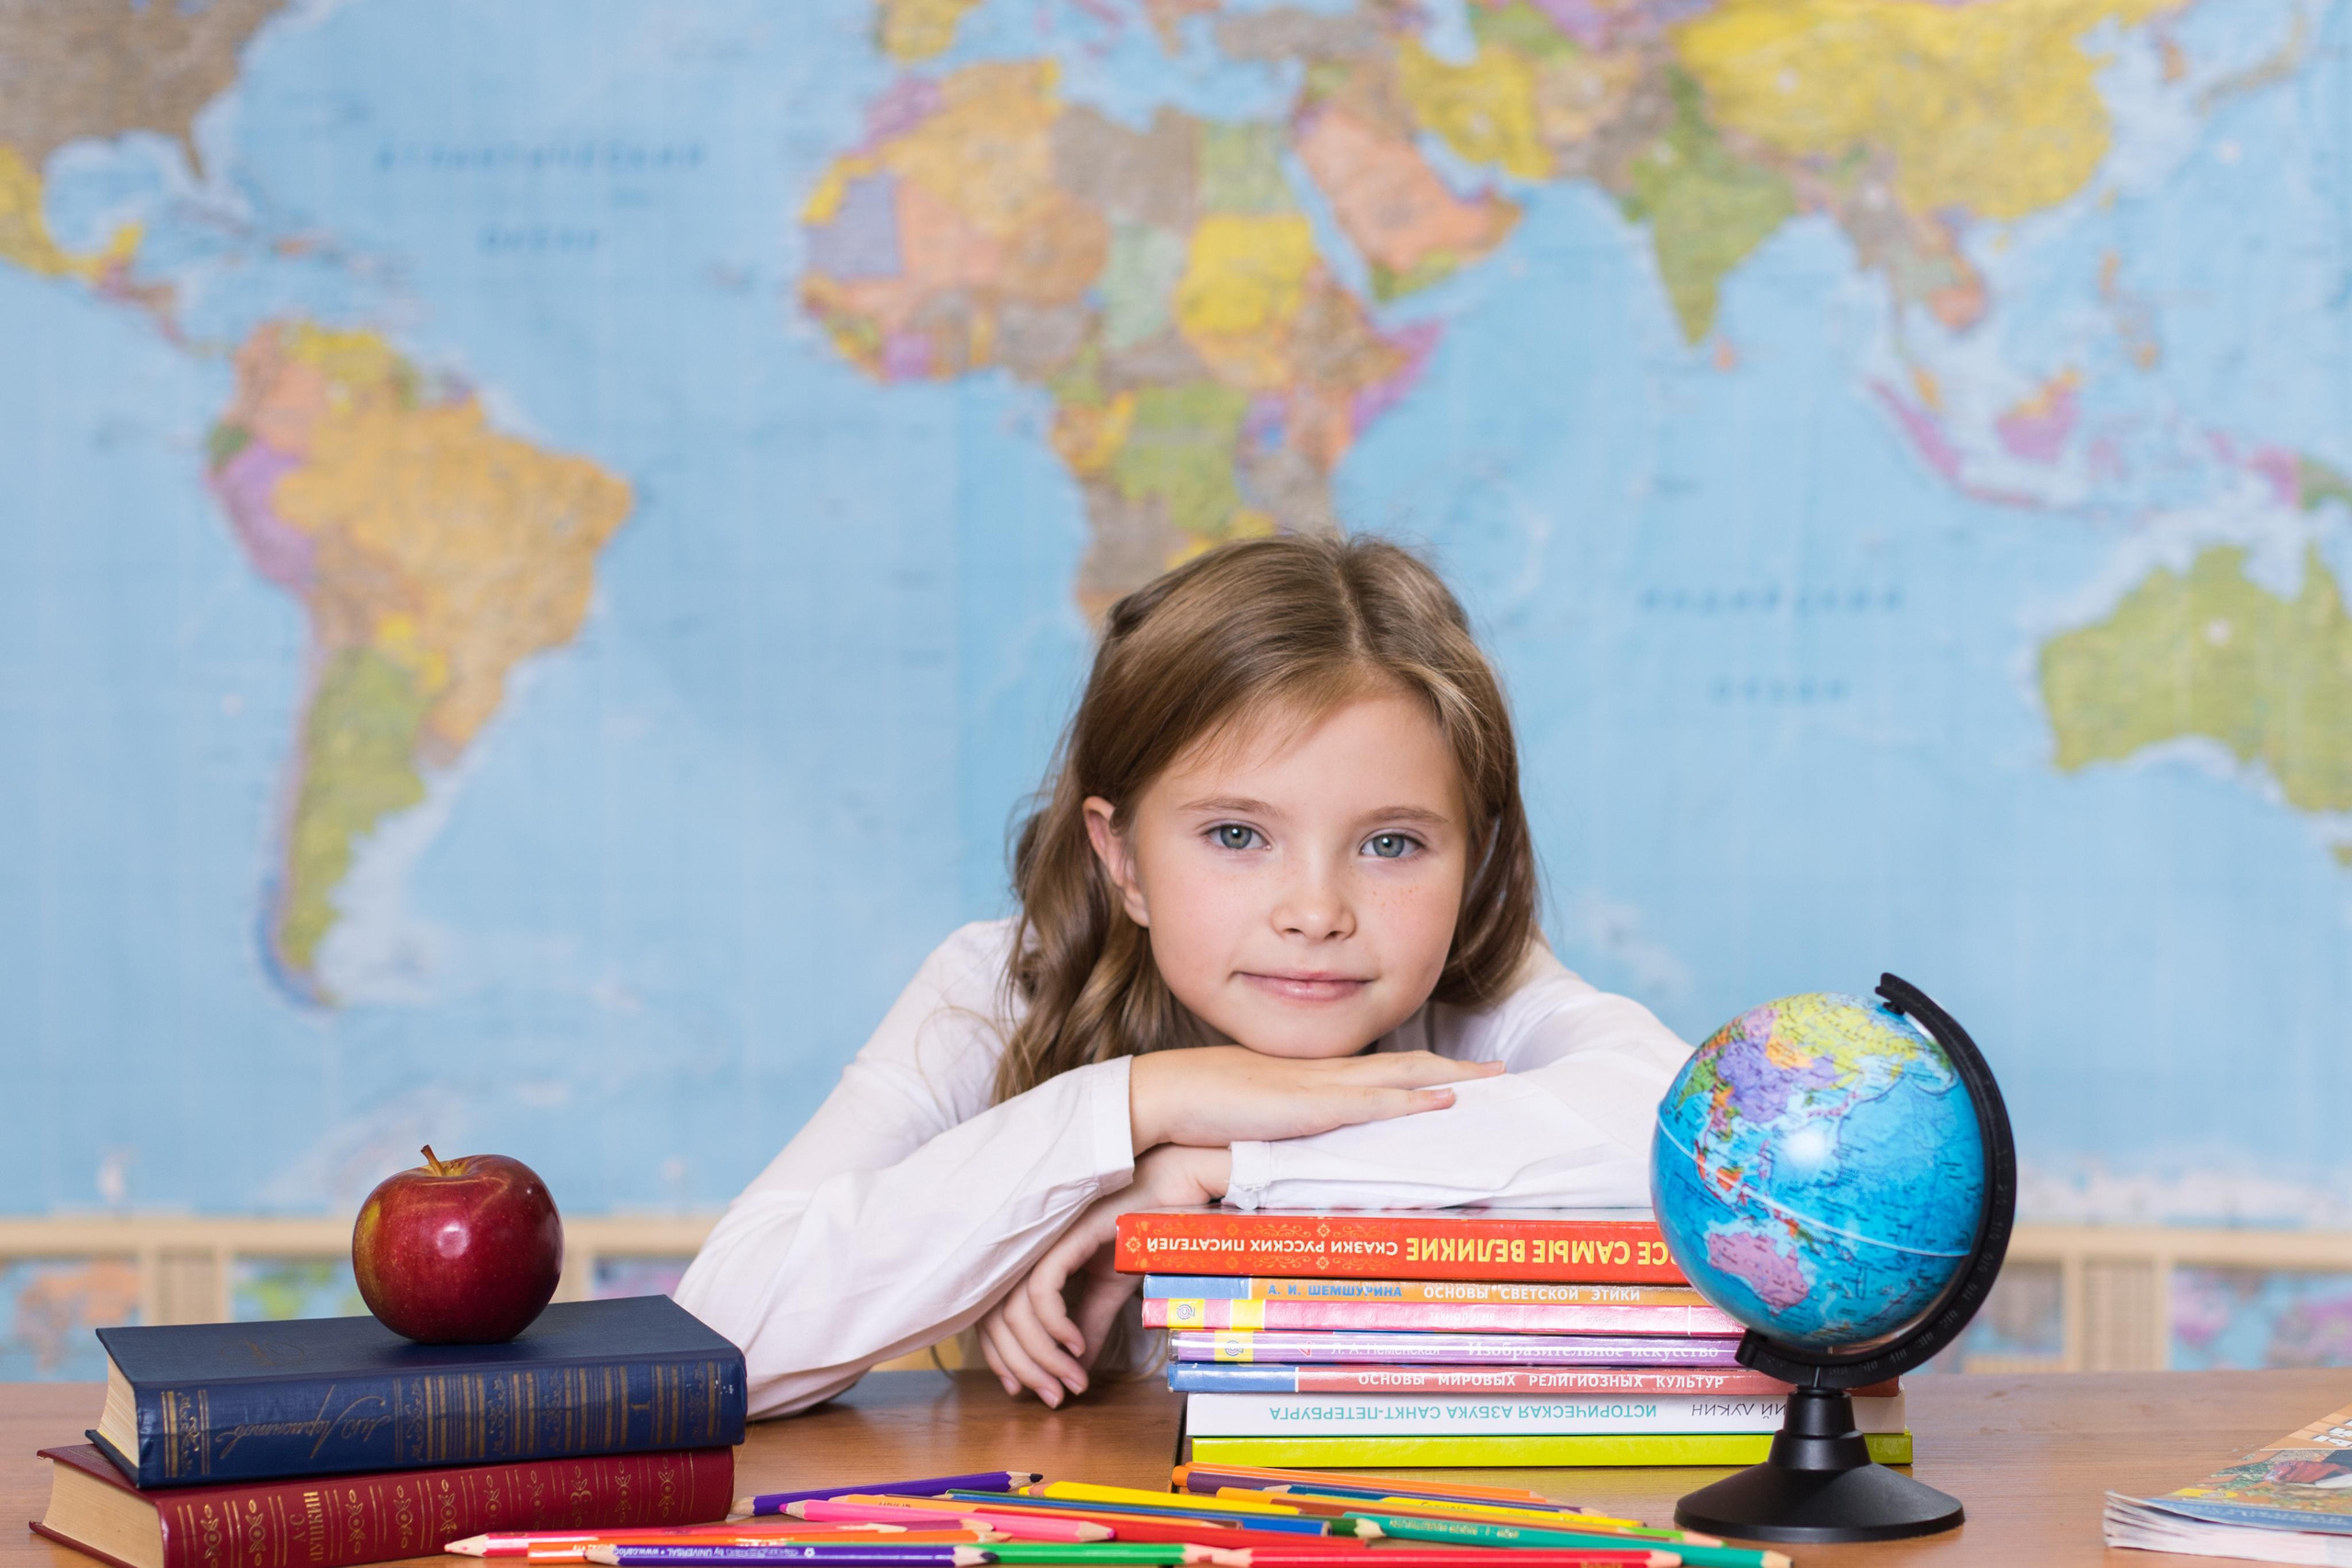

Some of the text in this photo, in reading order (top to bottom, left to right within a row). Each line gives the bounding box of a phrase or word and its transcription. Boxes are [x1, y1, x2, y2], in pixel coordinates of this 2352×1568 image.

[1147, 1237, 1678, 1266] СЕ САМЫЕ ВЕЛИКИЕ СКАЗКИ РУССКИХ ПИСАТЕЛЕЙ
[1268, 1285, 1641, 1302] А. И. ШЕМШУРИНА ОСНОВЫ СВЕТСКОЙ ЭТИКИ
[1430, 1311, 1496, 1322] ТЕХНОЛОГИЯ
[1467, 1342, 1623, 1360] Изобразительное
[1631, 1347, 1718, 1361] искусство
[1358, 1374, 1724, 1390] ОСНОВЫ МИРОВЫХ РЕЛИГИОЗНЫХ КУЛЬТУР
[1270, 1404, 1657, 1420] ИСТОРИЧЕСКАЯ АЗБУКА САНКТ-ПЕТЕРБУРГА
[1691, 1403, 1755, 1416] ЛУКИН
[303, 1491, 324, 1562] ПУШКИН
[666, 1547, 713, 1557] UNIVERSAL
